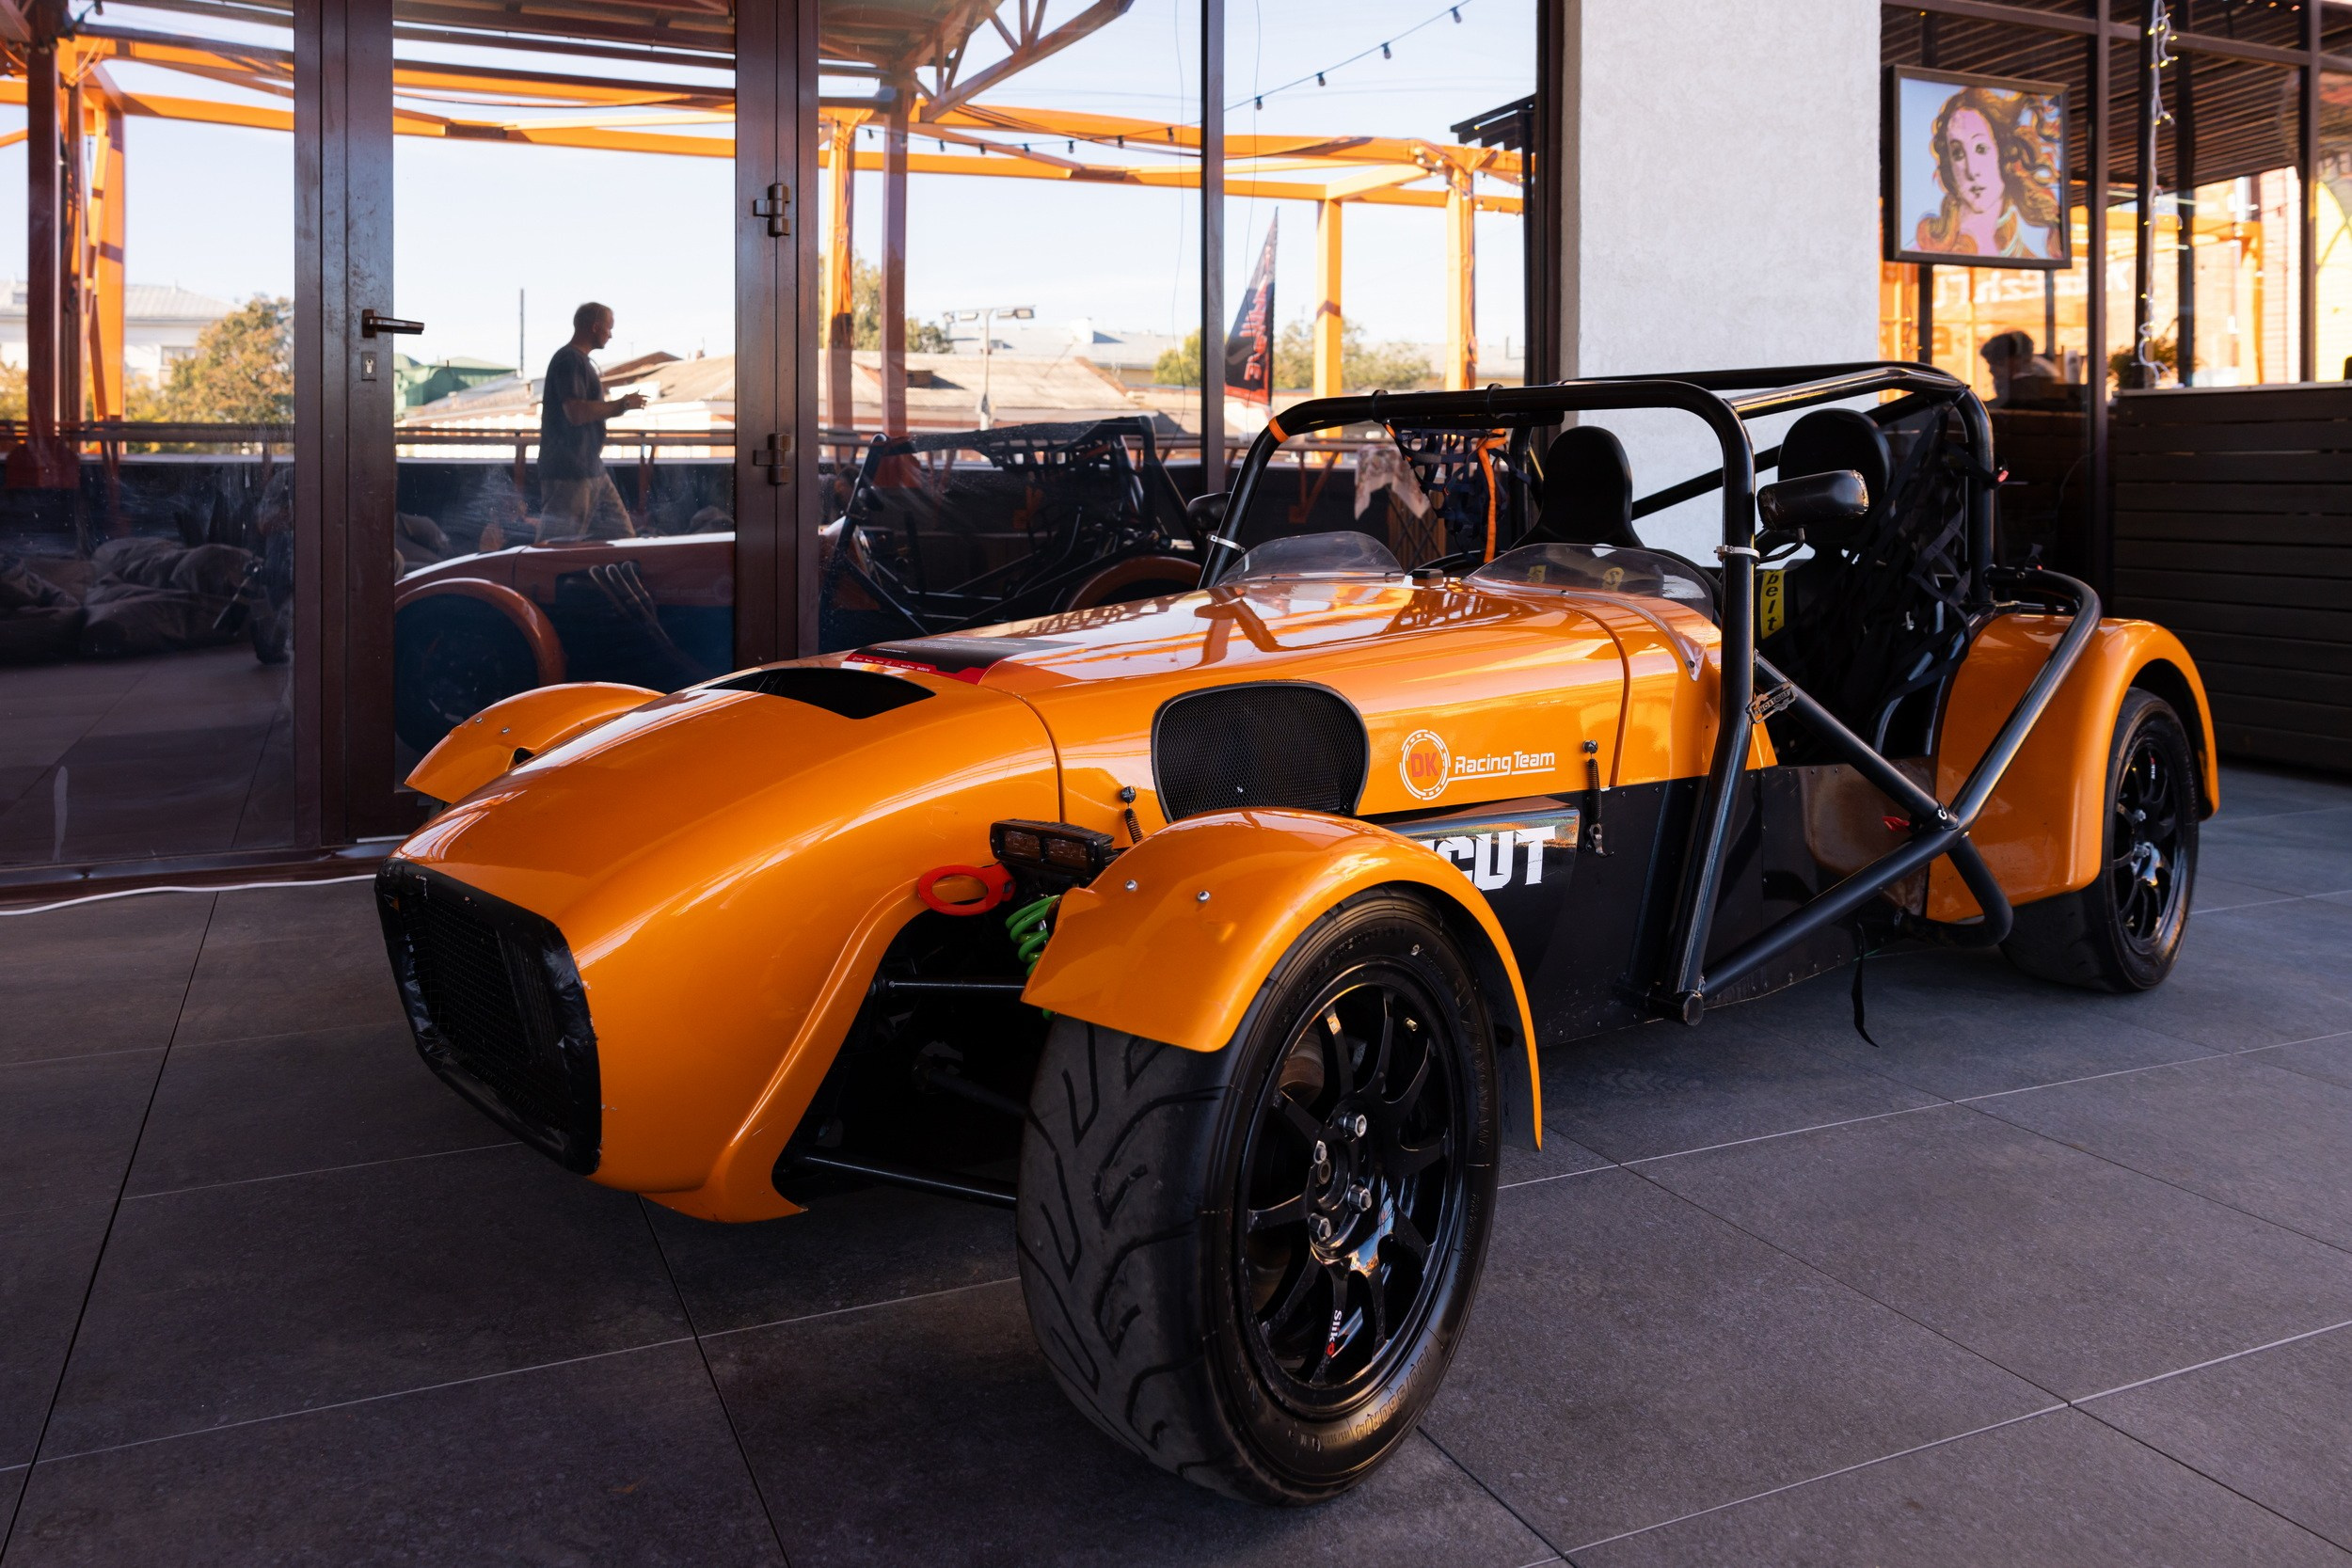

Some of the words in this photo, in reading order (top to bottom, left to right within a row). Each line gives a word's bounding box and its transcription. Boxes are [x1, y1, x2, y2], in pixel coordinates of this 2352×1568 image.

[1765, 570, 1780, 631] belt
[1454, 754, 1511, 775] Racing
[1513, 751, 1555, 768] Team
[1417, 825, 1556, 892] CUT
